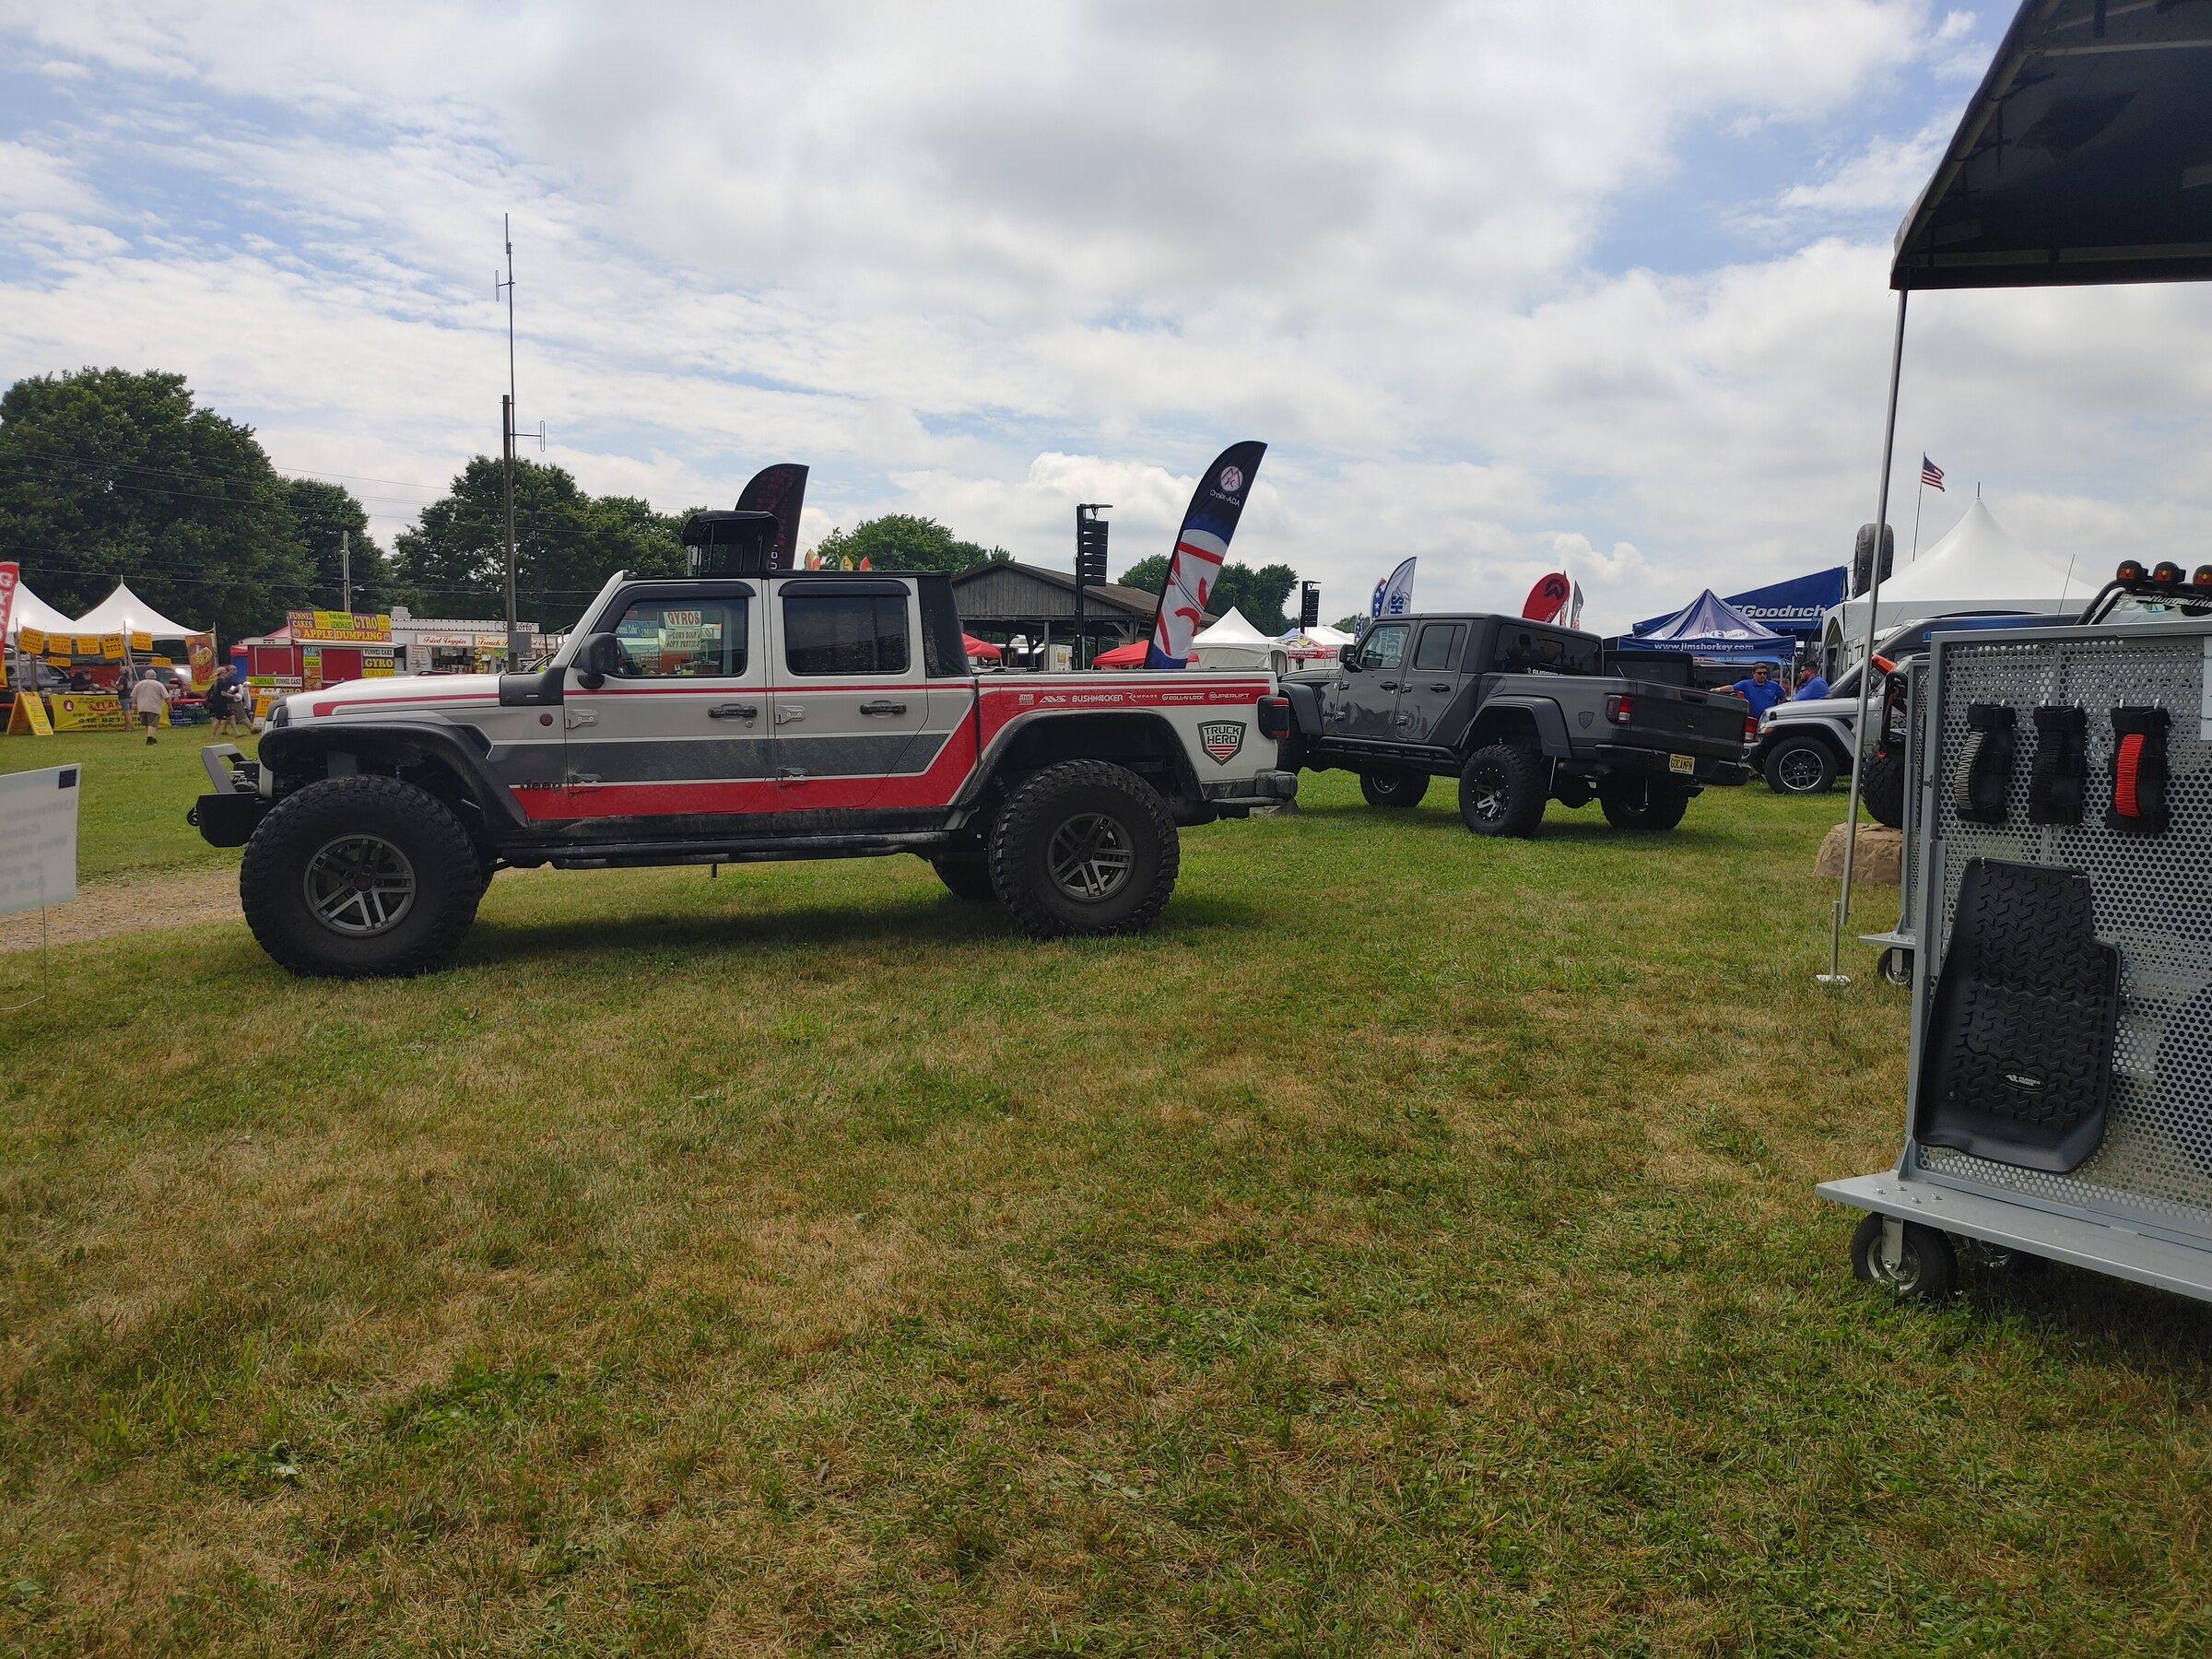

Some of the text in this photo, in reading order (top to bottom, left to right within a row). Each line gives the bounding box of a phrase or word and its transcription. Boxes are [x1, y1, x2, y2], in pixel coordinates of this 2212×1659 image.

[353, 615, 378, 629] GYRO
[666, 611, 700, 625] GYROS
[303, 629, 382, 641] APPLE DUMPLING
[1654, 641, 1754, 652] www.jimshorkey.com
[364, 658, 394, 667] GYRO
[1072, 694, 1124, 702] BUSHWACKER
[1125, 692, 1158, 702] RAMPAGE
[1208, 691, 1251, 700] SUPERLIFT
[1204, 725, 1241, 735] TRUCK
[1206, 735, 1238, 744] HERO
